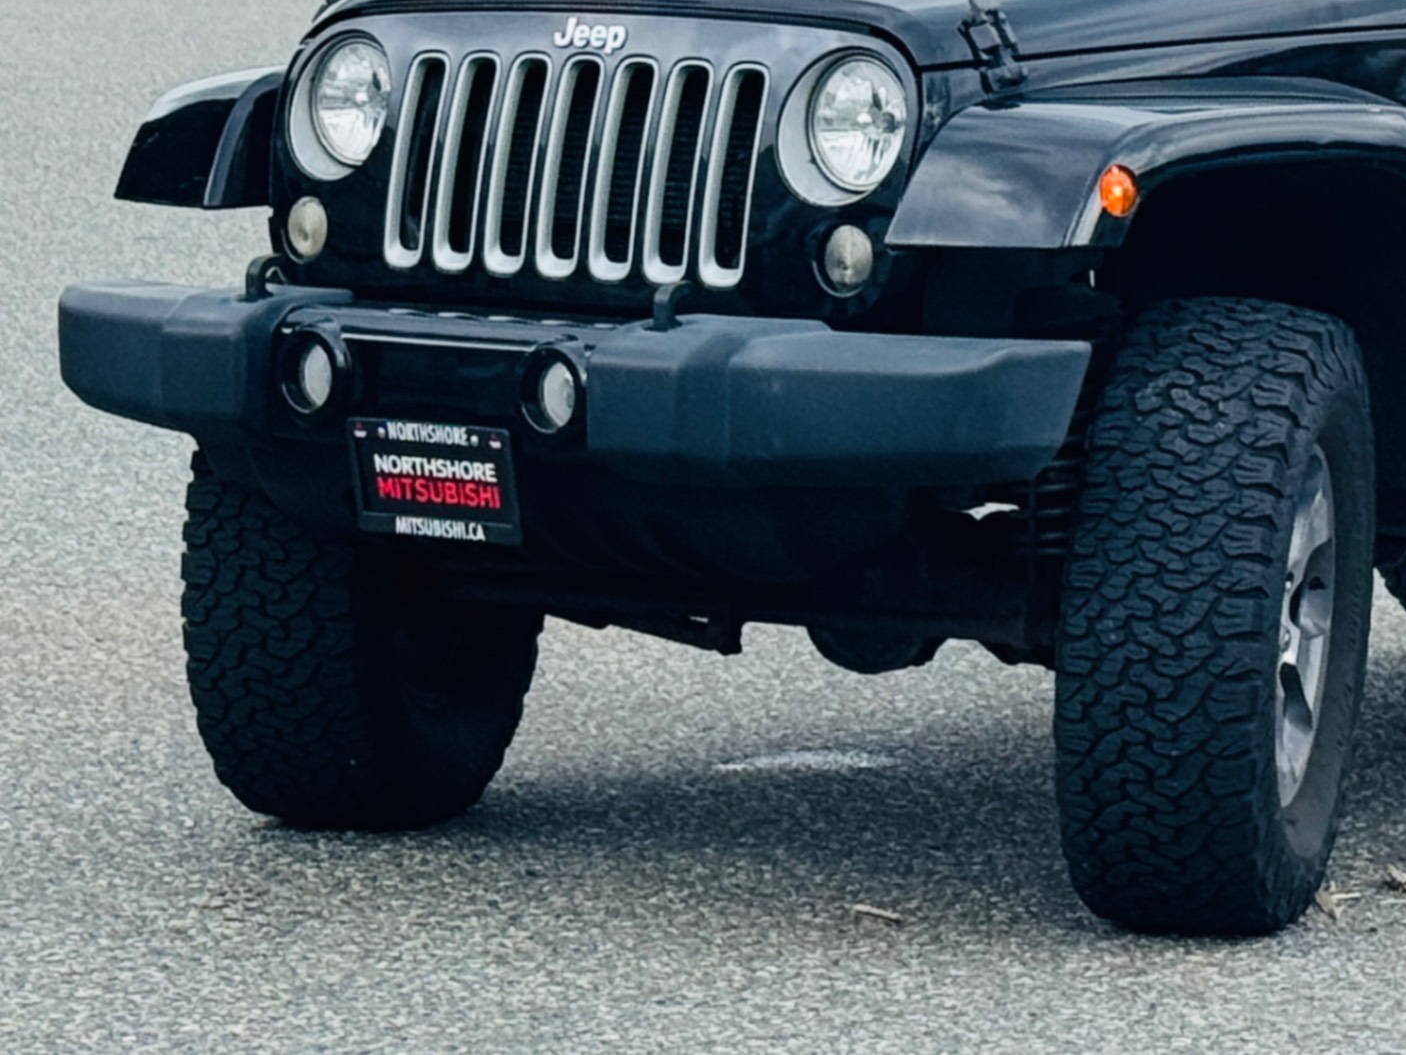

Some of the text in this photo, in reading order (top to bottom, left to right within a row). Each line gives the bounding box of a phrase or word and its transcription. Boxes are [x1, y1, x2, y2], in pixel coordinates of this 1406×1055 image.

[553, 16, 627, 55] Jeep
[386, 421, 469, 446] NORTHSHORE
[373, 453, 498, 483] NORTHSHORE
[376, 476, 501, 510] MITSUBISHI
[395, 515, 486, 542] MITSUBISHI.CA
